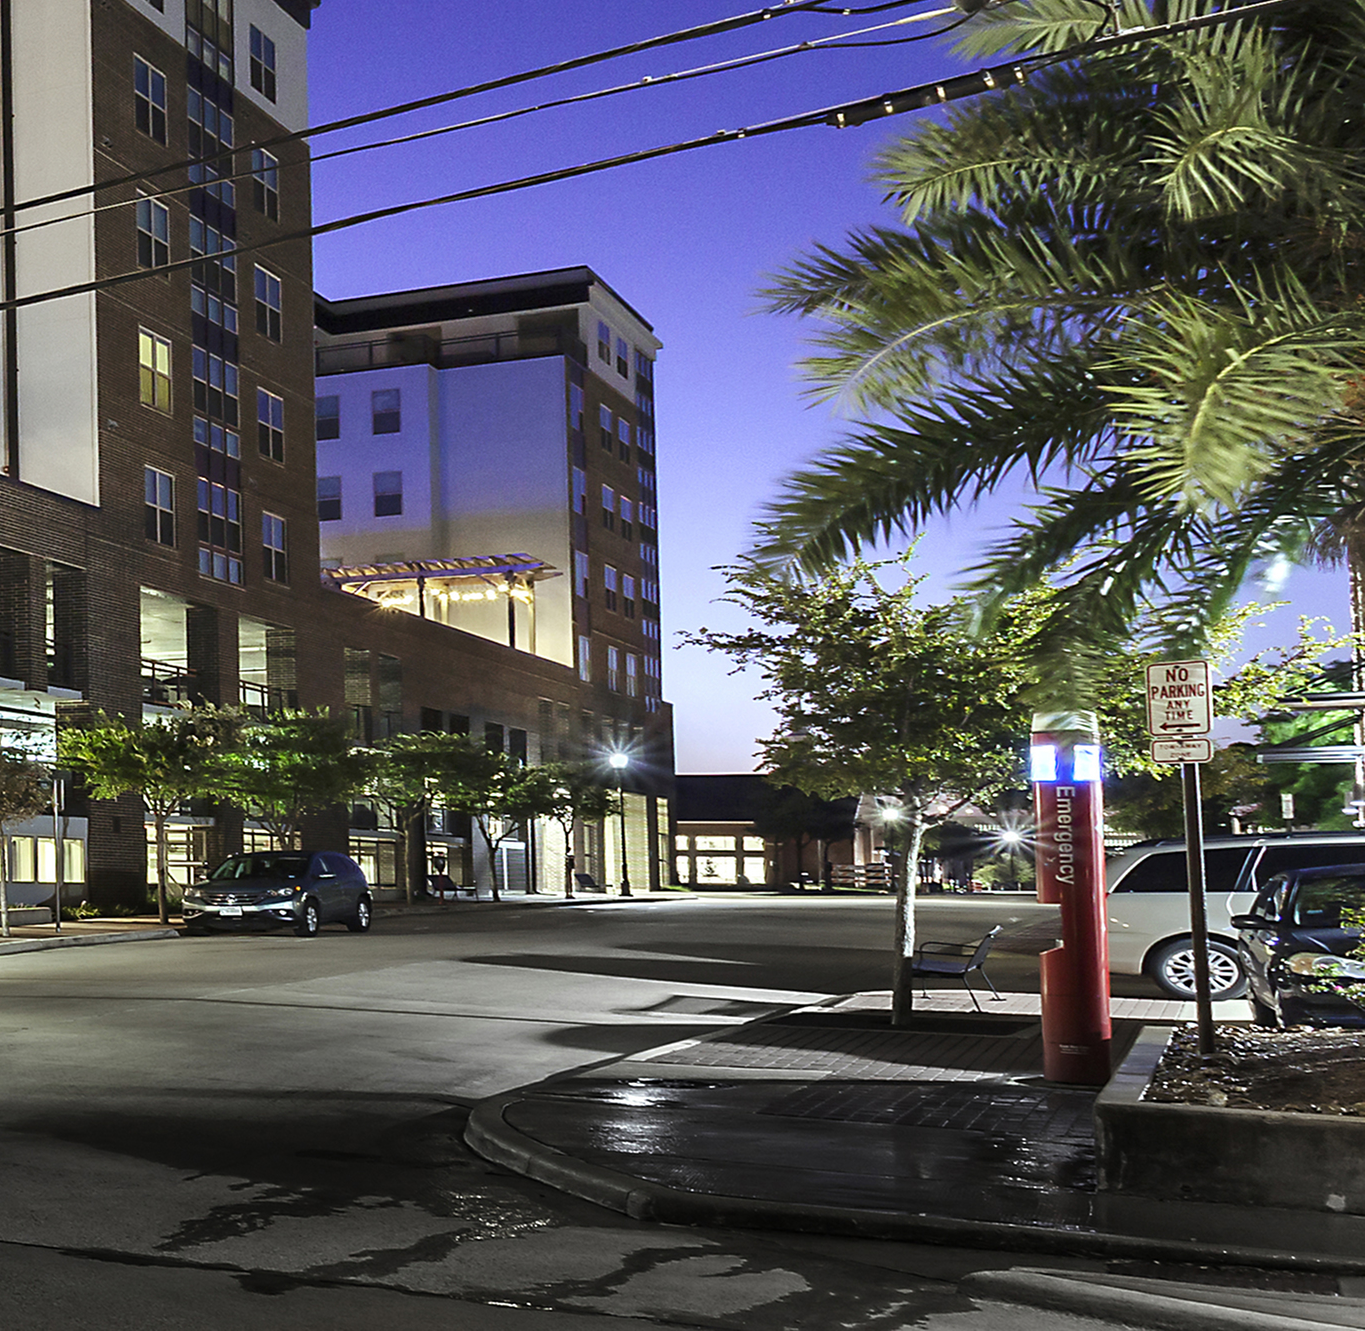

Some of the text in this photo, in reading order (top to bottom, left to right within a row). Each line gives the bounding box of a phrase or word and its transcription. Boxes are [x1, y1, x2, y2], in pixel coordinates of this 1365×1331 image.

[1166, 668, 1189, 683] NO
[1151, 683, 1205, 699] PARKING
[1166, 700, 1190, 710] ANY
[1165, 709, 1194, 721] TIME
[1054, 786, 1076, 885] Emergency
